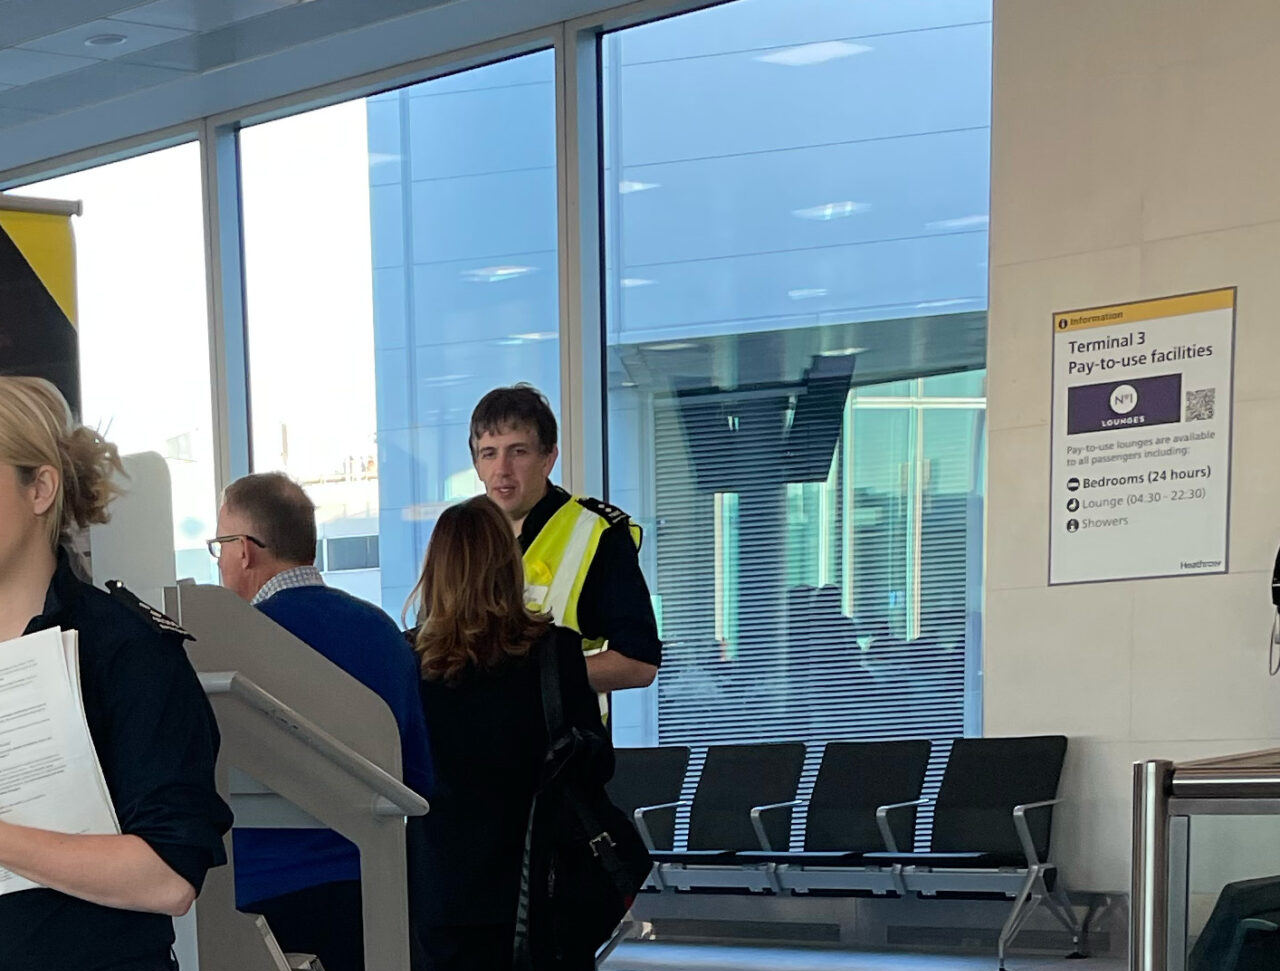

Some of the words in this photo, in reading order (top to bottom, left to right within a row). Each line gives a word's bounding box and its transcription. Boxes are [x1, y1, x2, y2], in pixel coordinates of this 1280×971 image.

[1070, 311, 1124, 326] Information
[1068, 332, 1133, 354] Terminal
[1137, 331, 1146, 345] 3
[1068, 353, 1147, 376] Pay-to-use
[1151, 343, 1213, 364] facilities
[1101, 415, 1145, 428] LOUNGES
[1067, 442, 1114, 455] Pay-to-use
[1117, 437, 1153, 450] lounges
[1155, 436, 1171, 445] are
[1173, 431, 1216, 443] available
[1067, 458, 1077, 466] to
[1078, 454, 1089, 465] all
[1091, 452, 1142, 465] passengers
[1083, 473, 1145, 489] Bedrooms
[1147, 470, 1167, 484] (24
[1170, 464, 1212, 480] hours)
[1082, 495, 1124, 511] Lounge
[1082, 515, 1129, 529] Showers
